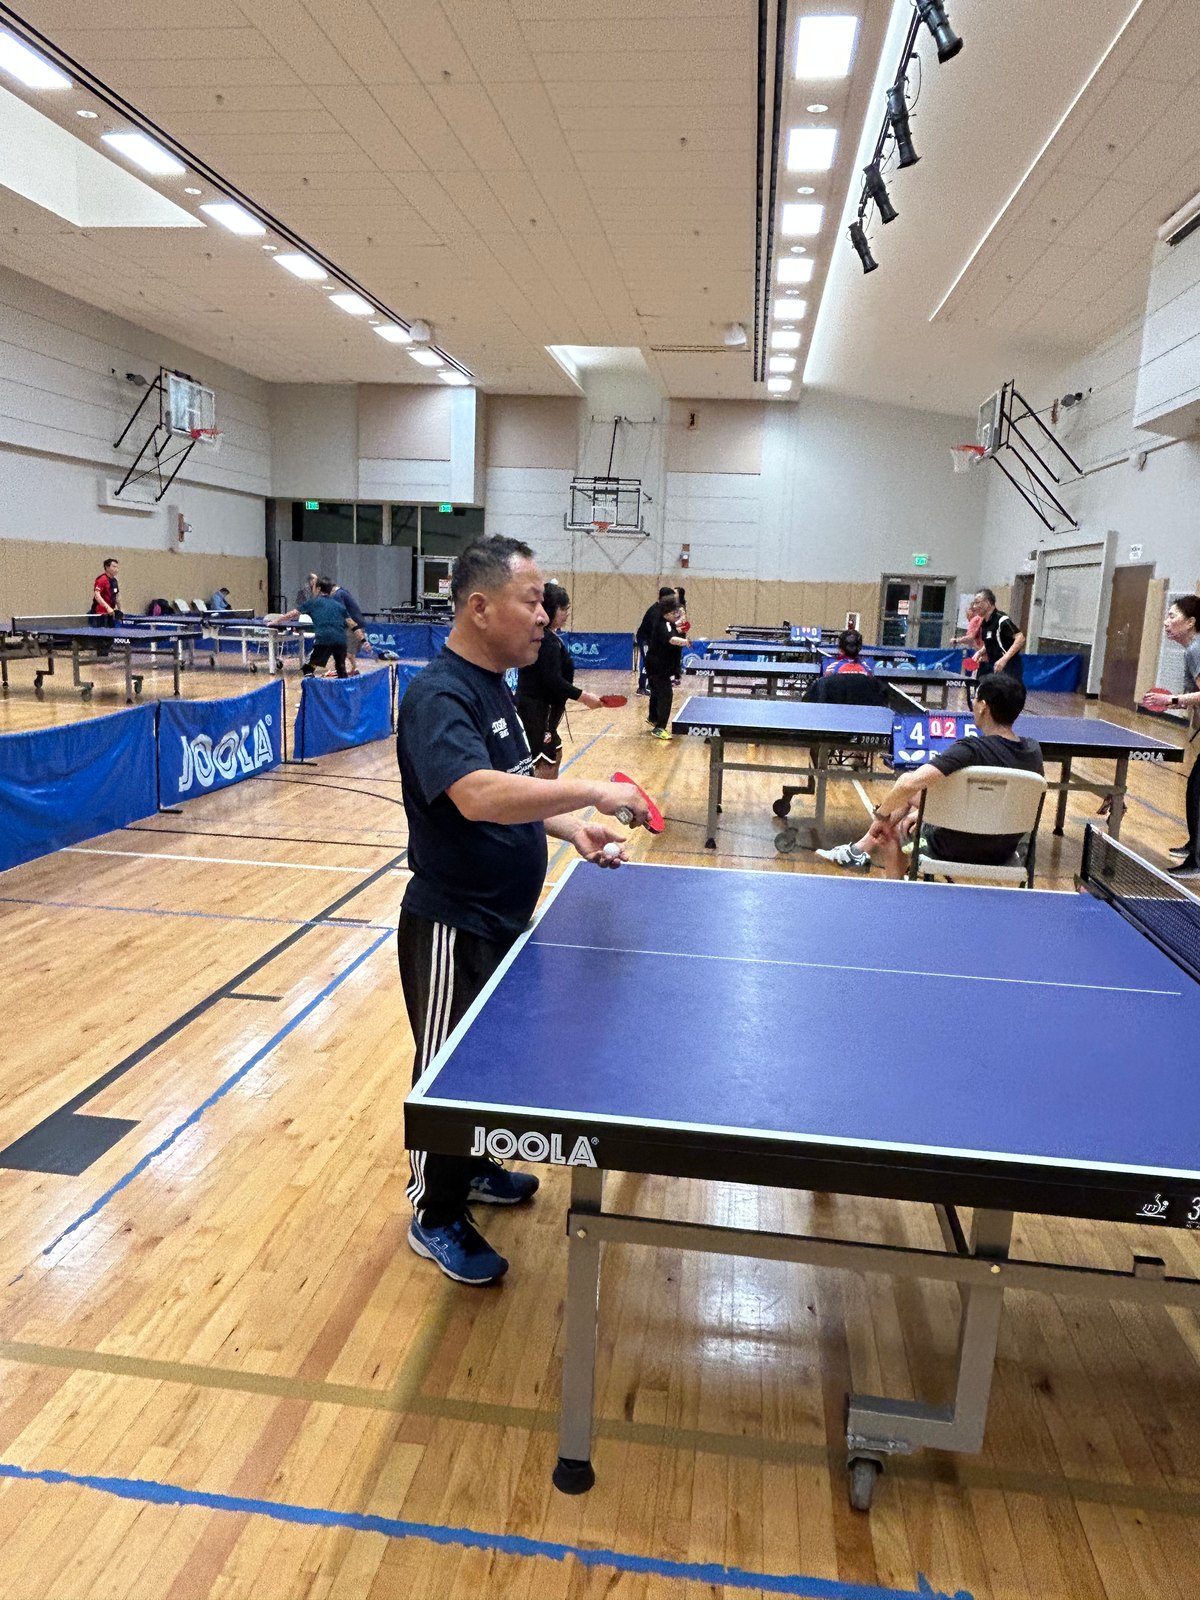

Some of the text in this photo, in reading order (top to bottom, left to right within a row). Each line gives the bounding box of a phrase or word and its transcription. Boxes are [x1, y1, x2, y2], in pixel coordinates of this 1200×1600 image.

[365, 633, 396, 645] OLA
[568, 643, 600, 655] OLA
[687, 726, 721, 737] JOOLA
[909, 722, 925, 745] 4
